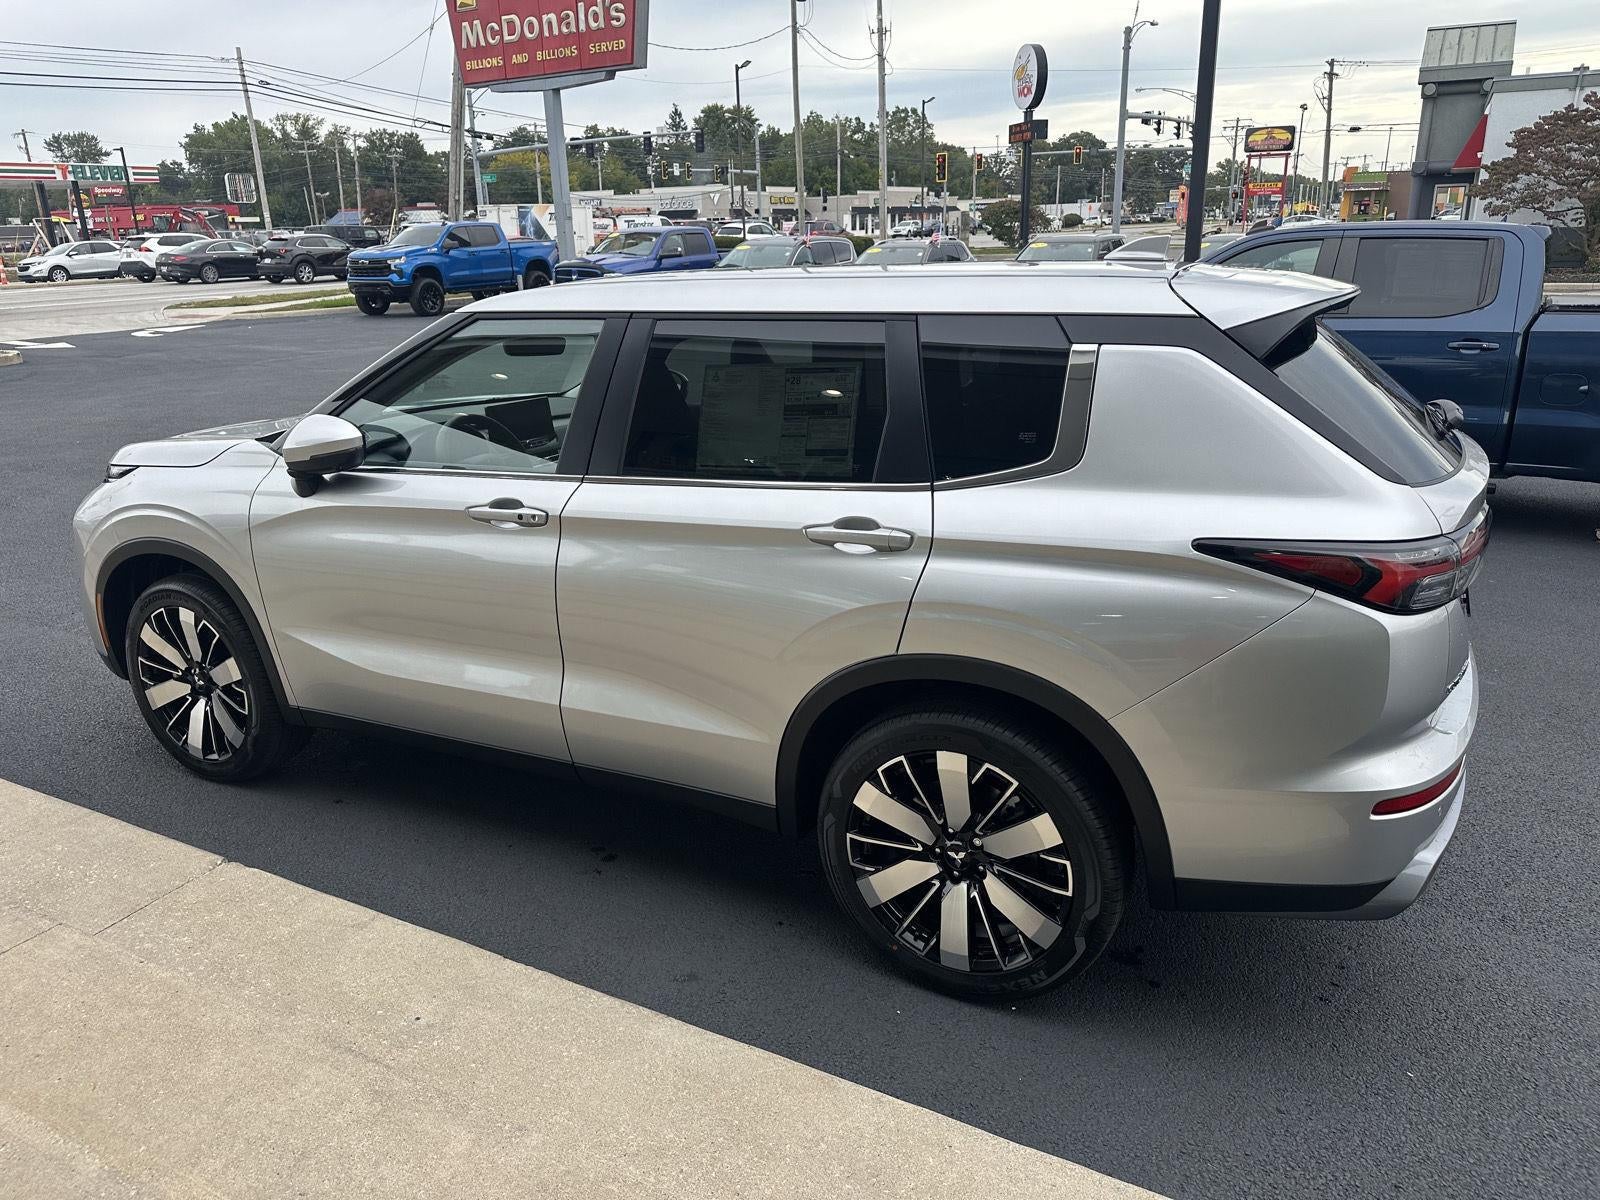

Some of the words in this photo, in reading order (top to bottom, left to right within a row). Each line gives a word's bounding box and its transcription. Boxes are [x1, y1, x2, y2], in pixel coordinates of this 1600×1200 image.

[461, 0, 627, 49] McDonald's
[465, 56, 503, 71] BILLIONS
[511, 53, 529, 65] AND
[536, 45, 578, 61] BILLIONS
[589, 39, 626, 54] SERVED
[1017, 84, 1033, 98] WOK
[94, 186, 123, 194] Speedway
